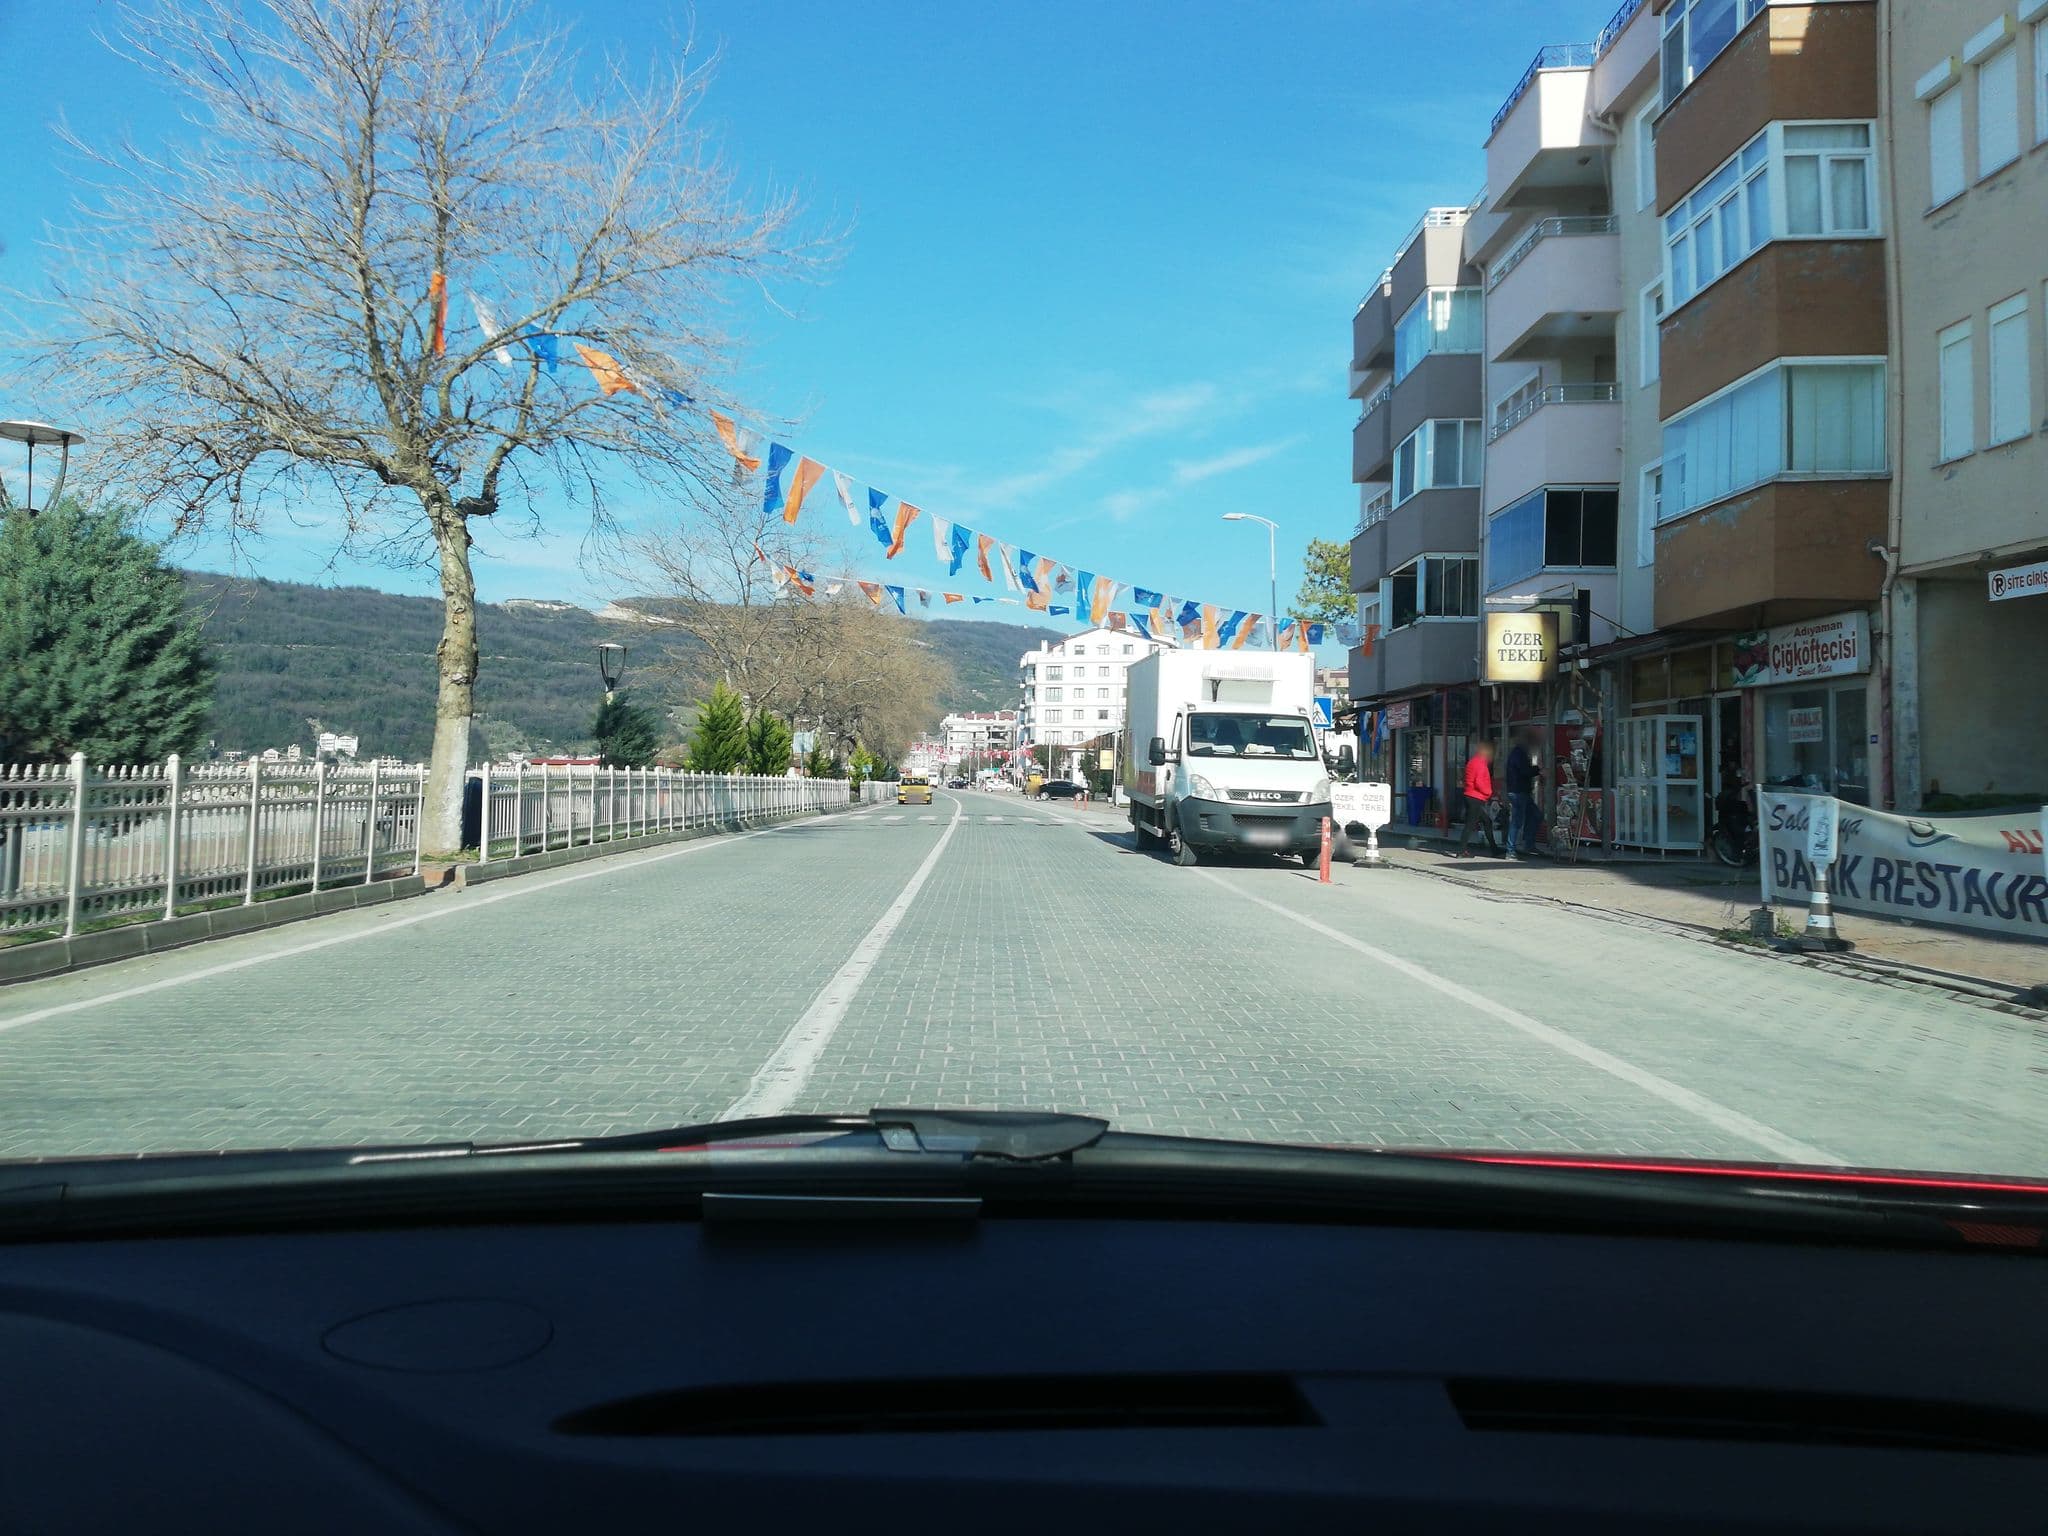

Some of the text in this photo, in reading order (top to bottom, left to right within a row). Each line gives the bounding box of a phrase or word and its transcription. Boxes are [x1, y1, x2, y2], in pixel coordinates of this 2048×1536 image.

[2008, 574, 2025, 590] SİTE
[1794, 621, 1842, 637] Adıyaman
[1502, 629, 1543, 646] ÖZER
[1498, 648, 1548, 662] TEKEL
[1772, 631, 1856, 676] Çiğköftecisi
[1247, 791, 1282, 800] IVECO
[1773, 847, 1864, 899] BAIK
